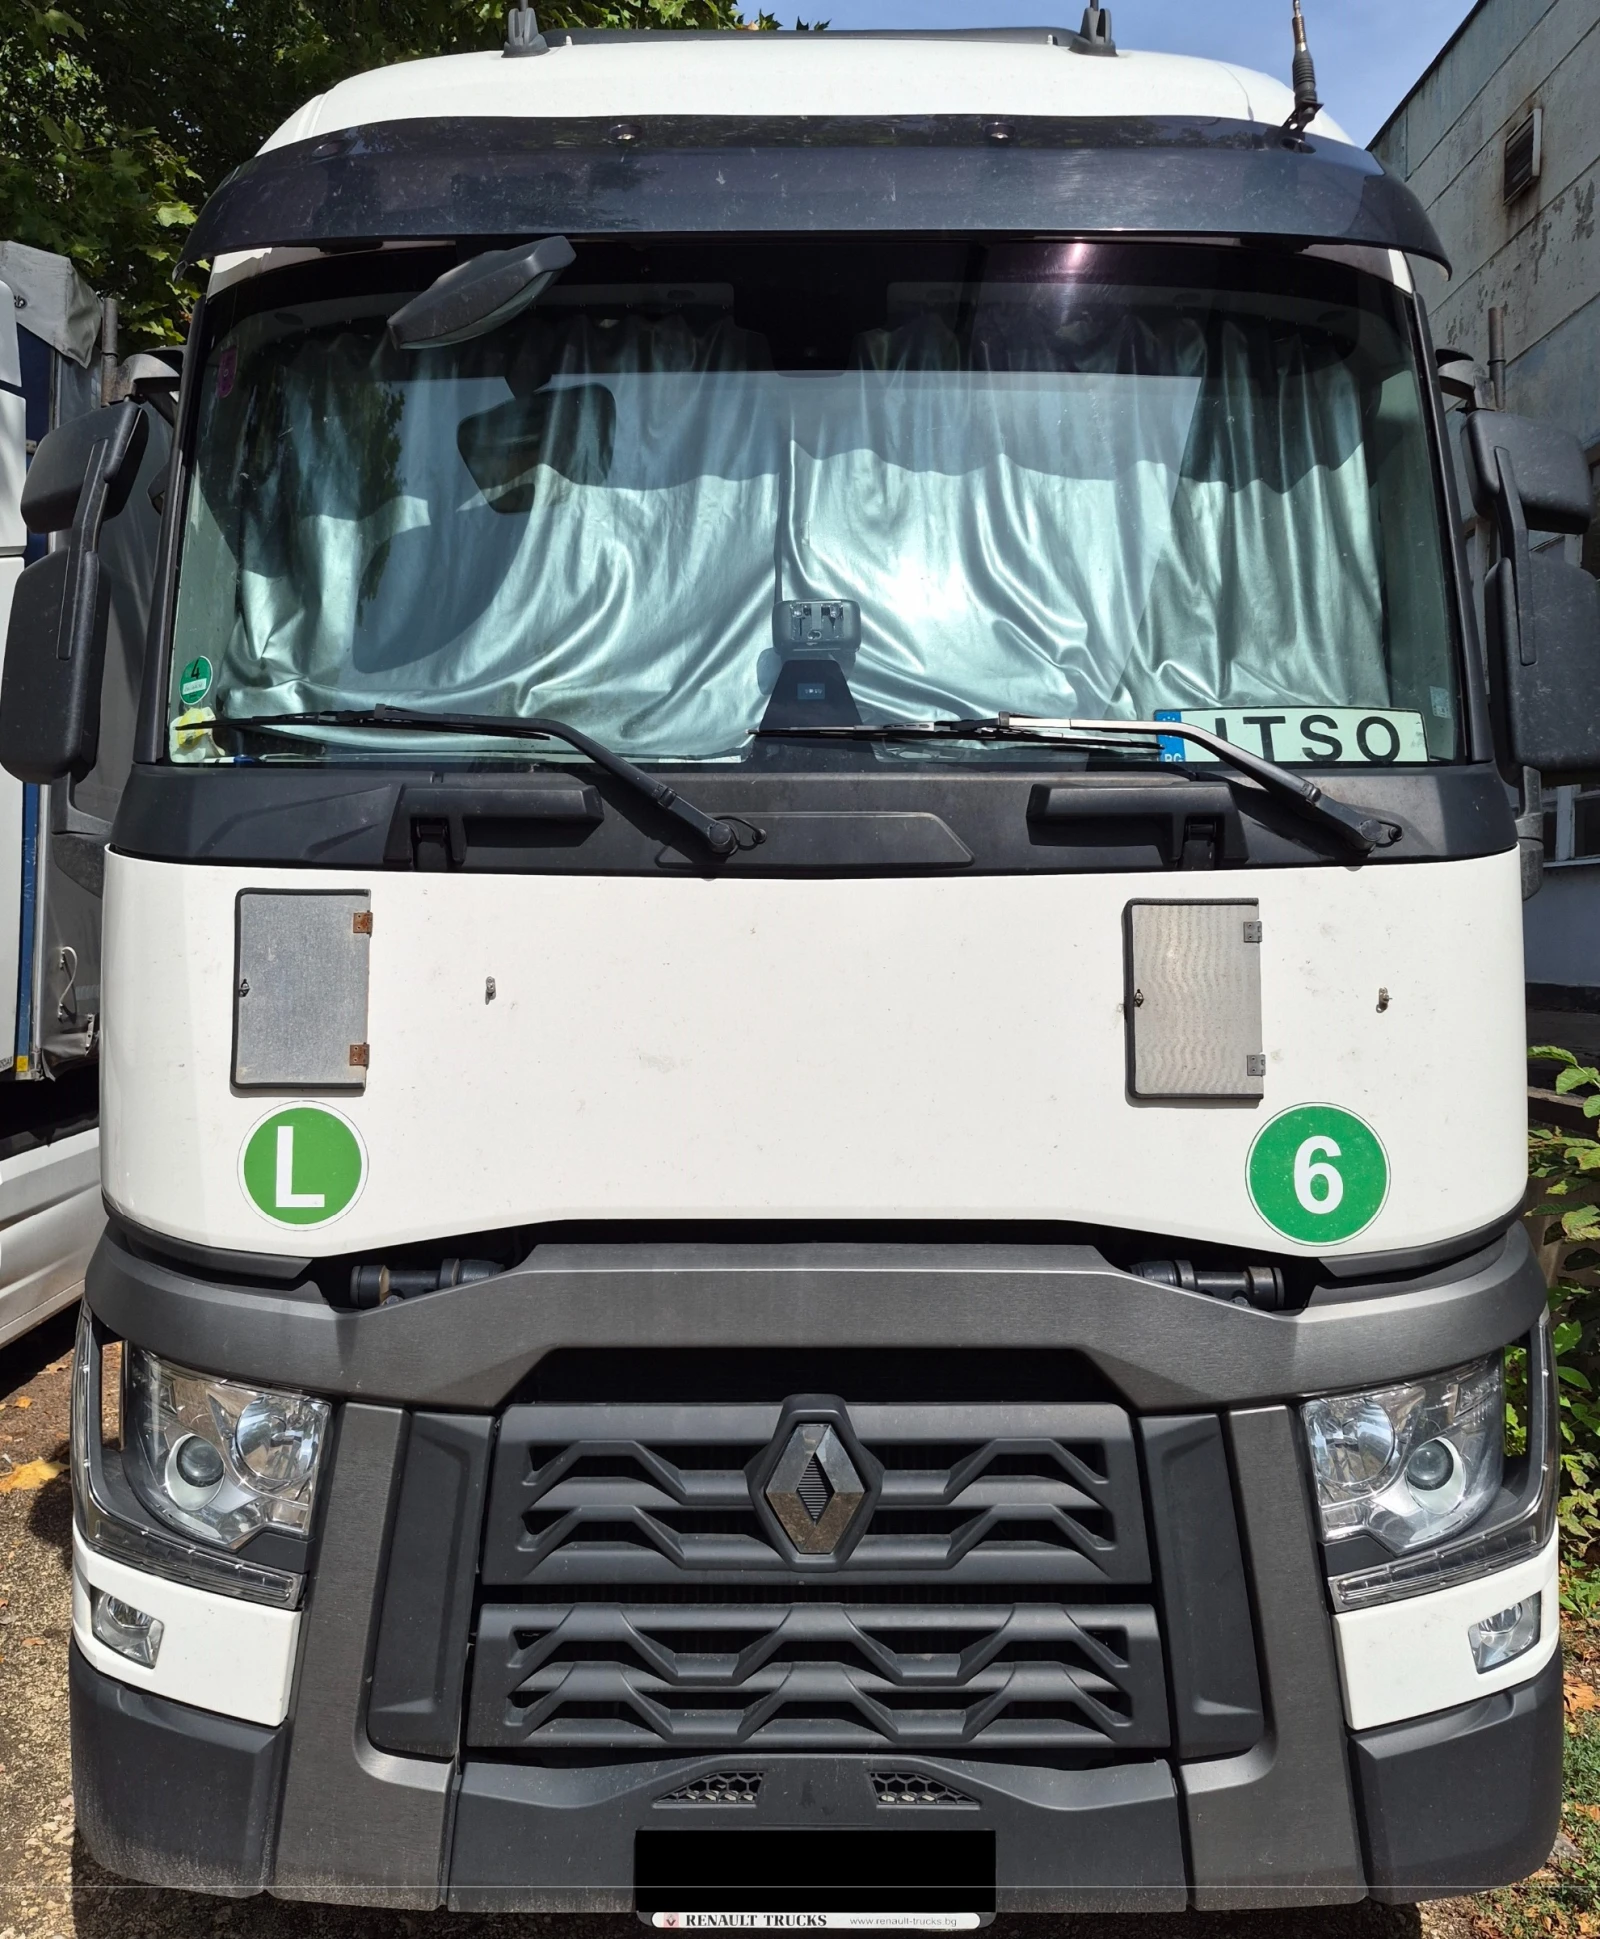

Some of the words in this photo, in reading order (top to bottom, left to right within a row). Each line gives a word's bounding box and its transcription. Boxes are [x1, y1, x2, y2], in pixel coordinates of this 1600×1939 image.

[190, 658, 200, 679] 4
[275, 1126, 325, 1207] L
[1294, 1135, 1343, 1214] 6
[686, 1915, 757, 1926] RENAULT
[764, 1915, 827, 1927] TRUCKS
[850, 1917, 957, 1927] www.renault-trucks.bg
